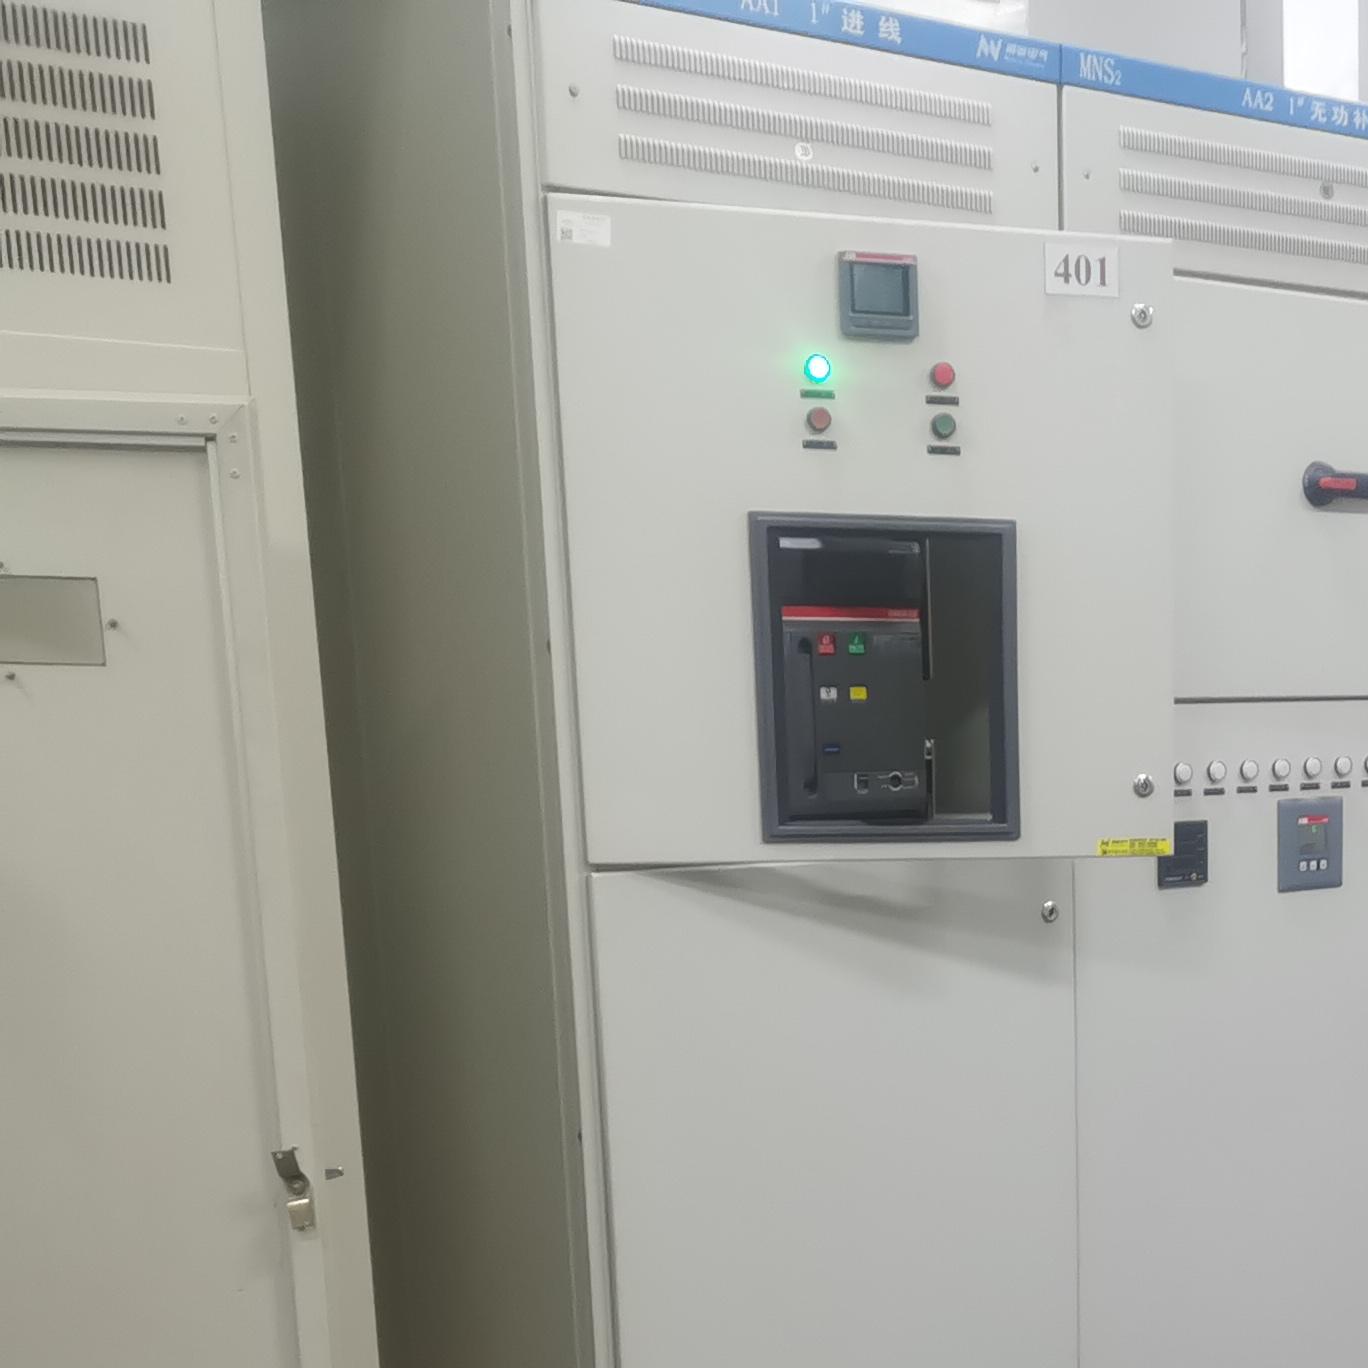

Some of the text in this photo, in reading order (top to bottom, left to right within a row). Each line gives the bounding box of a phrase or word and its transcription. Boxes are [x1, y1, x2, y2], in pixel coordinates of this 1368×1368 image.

[841, 8, 902, 44] 进线
[1241, 87, 1274, 112] AA2
[1053, 253, 1107, 287] 401
